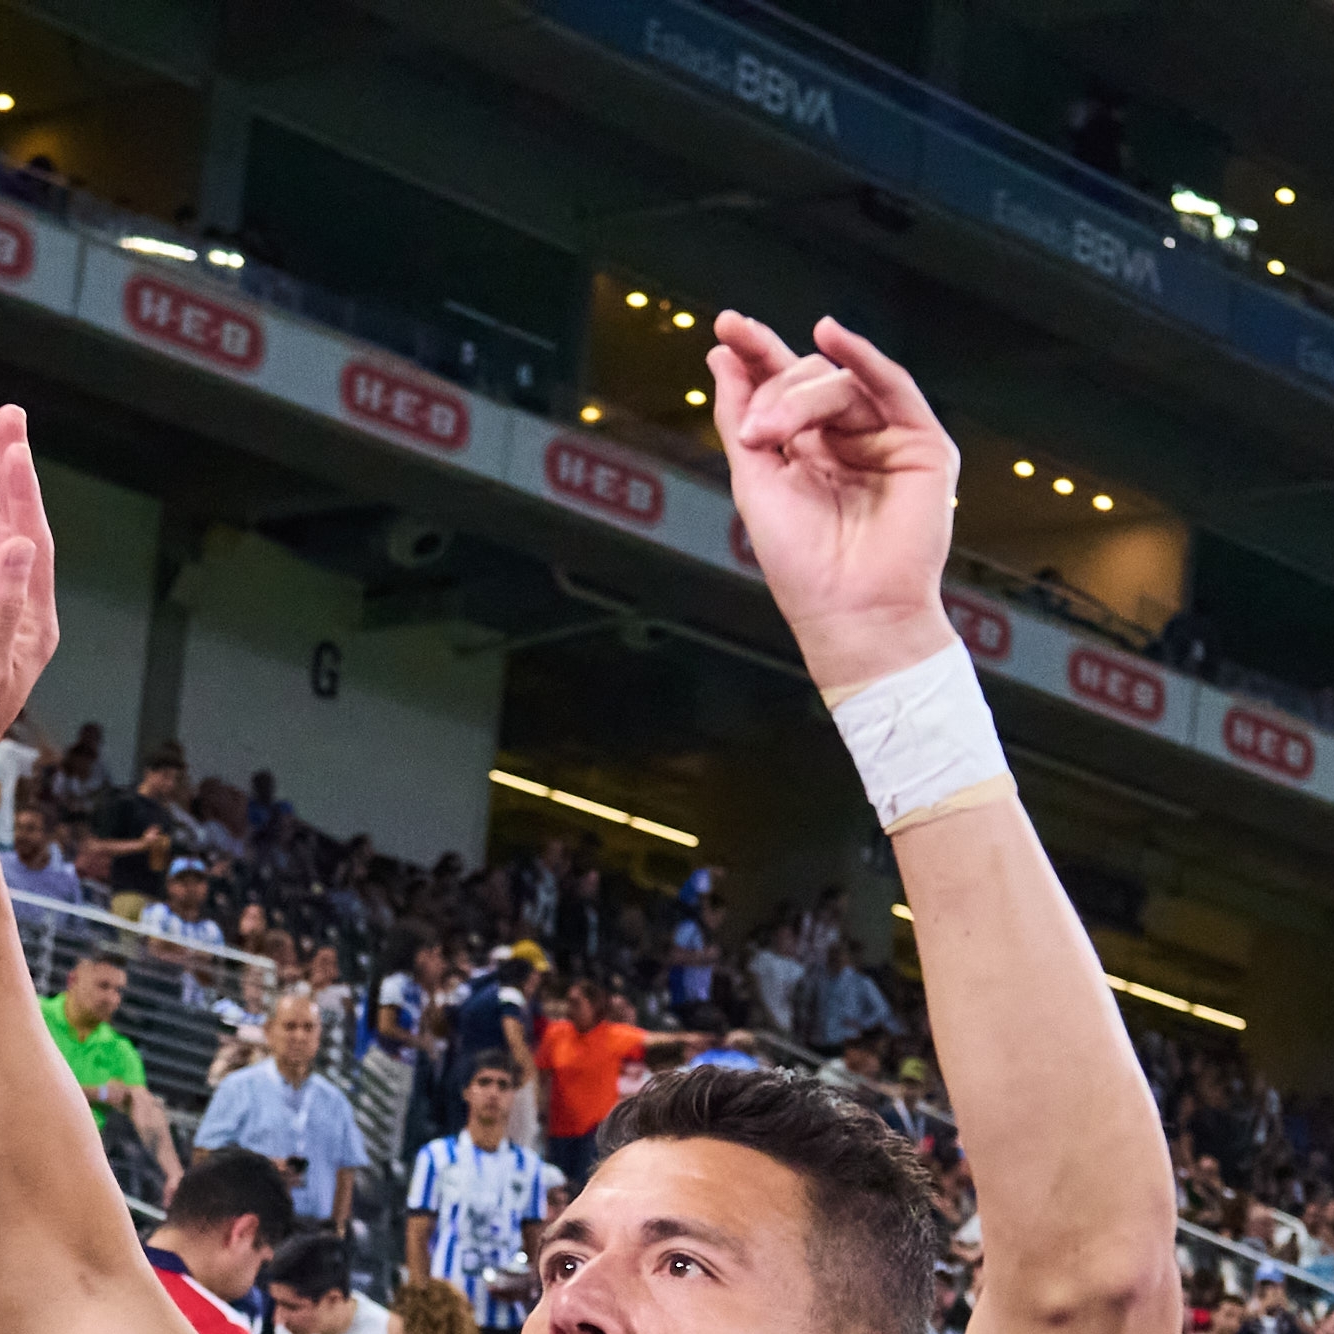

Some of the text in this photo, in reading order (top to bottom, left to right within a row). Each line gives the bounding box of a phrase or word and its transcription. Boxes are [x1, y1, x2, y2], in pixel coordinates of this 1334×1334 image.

[735, 53, 838, 136] BBVA
[1072, 220, 1163, 295] BBVA
[311, 641, 342, 698] G
